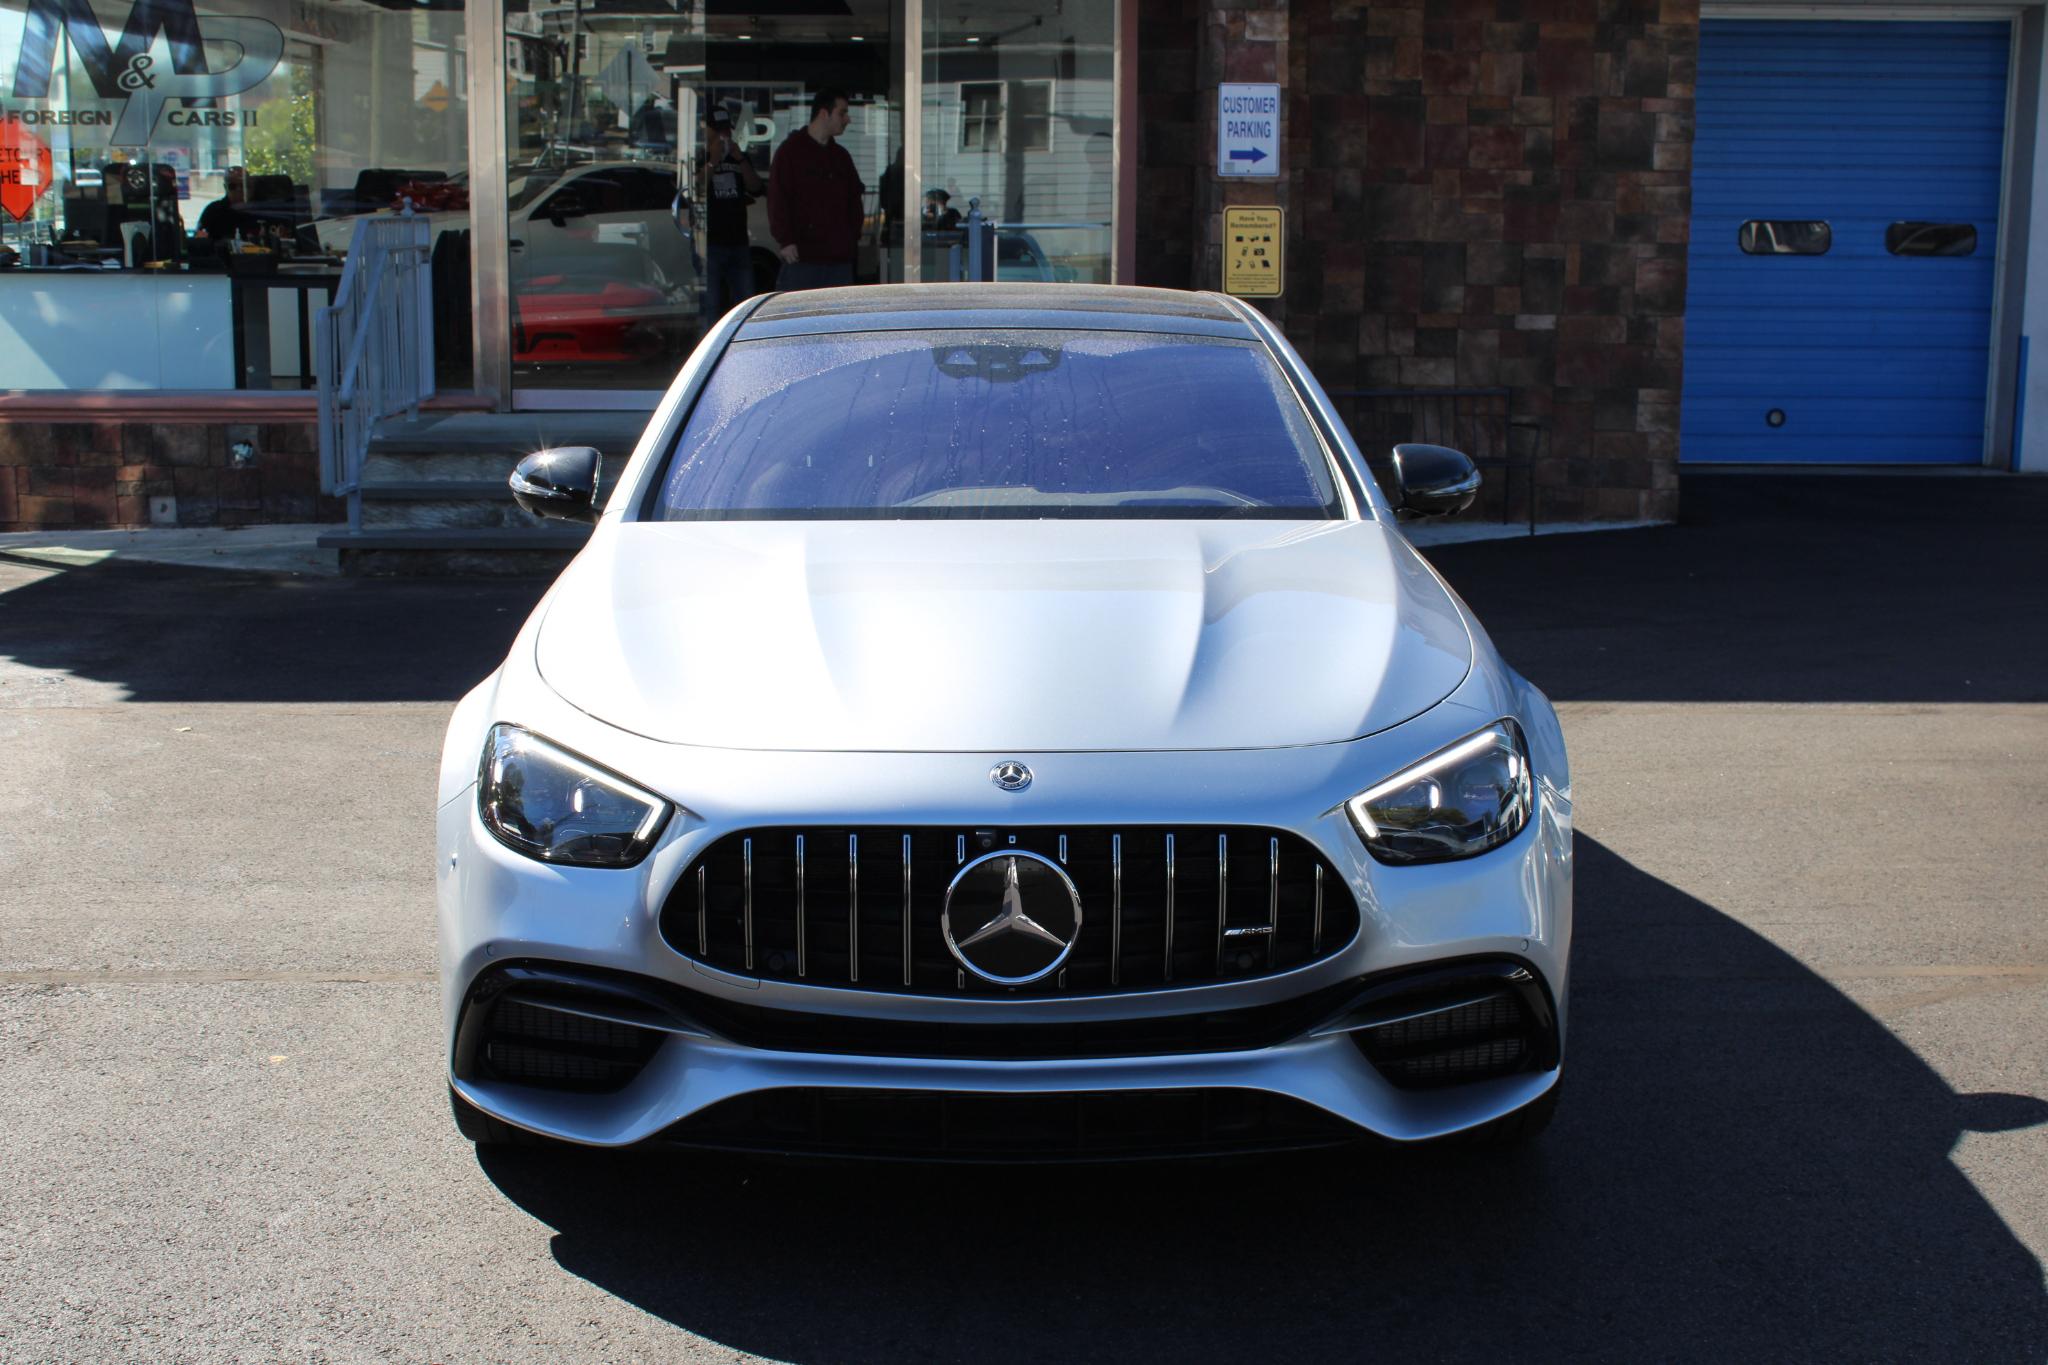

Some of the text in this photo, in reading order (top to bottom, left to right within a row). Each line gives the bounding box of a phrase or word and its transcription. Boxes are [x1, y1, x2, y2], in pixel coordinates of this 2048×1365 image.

[1222, 96, 1276, 114] CUSTOMER
[8, 110, 258, 126] FOREIGN CARS II
[1227, 121, 1271, 139] PARKING
